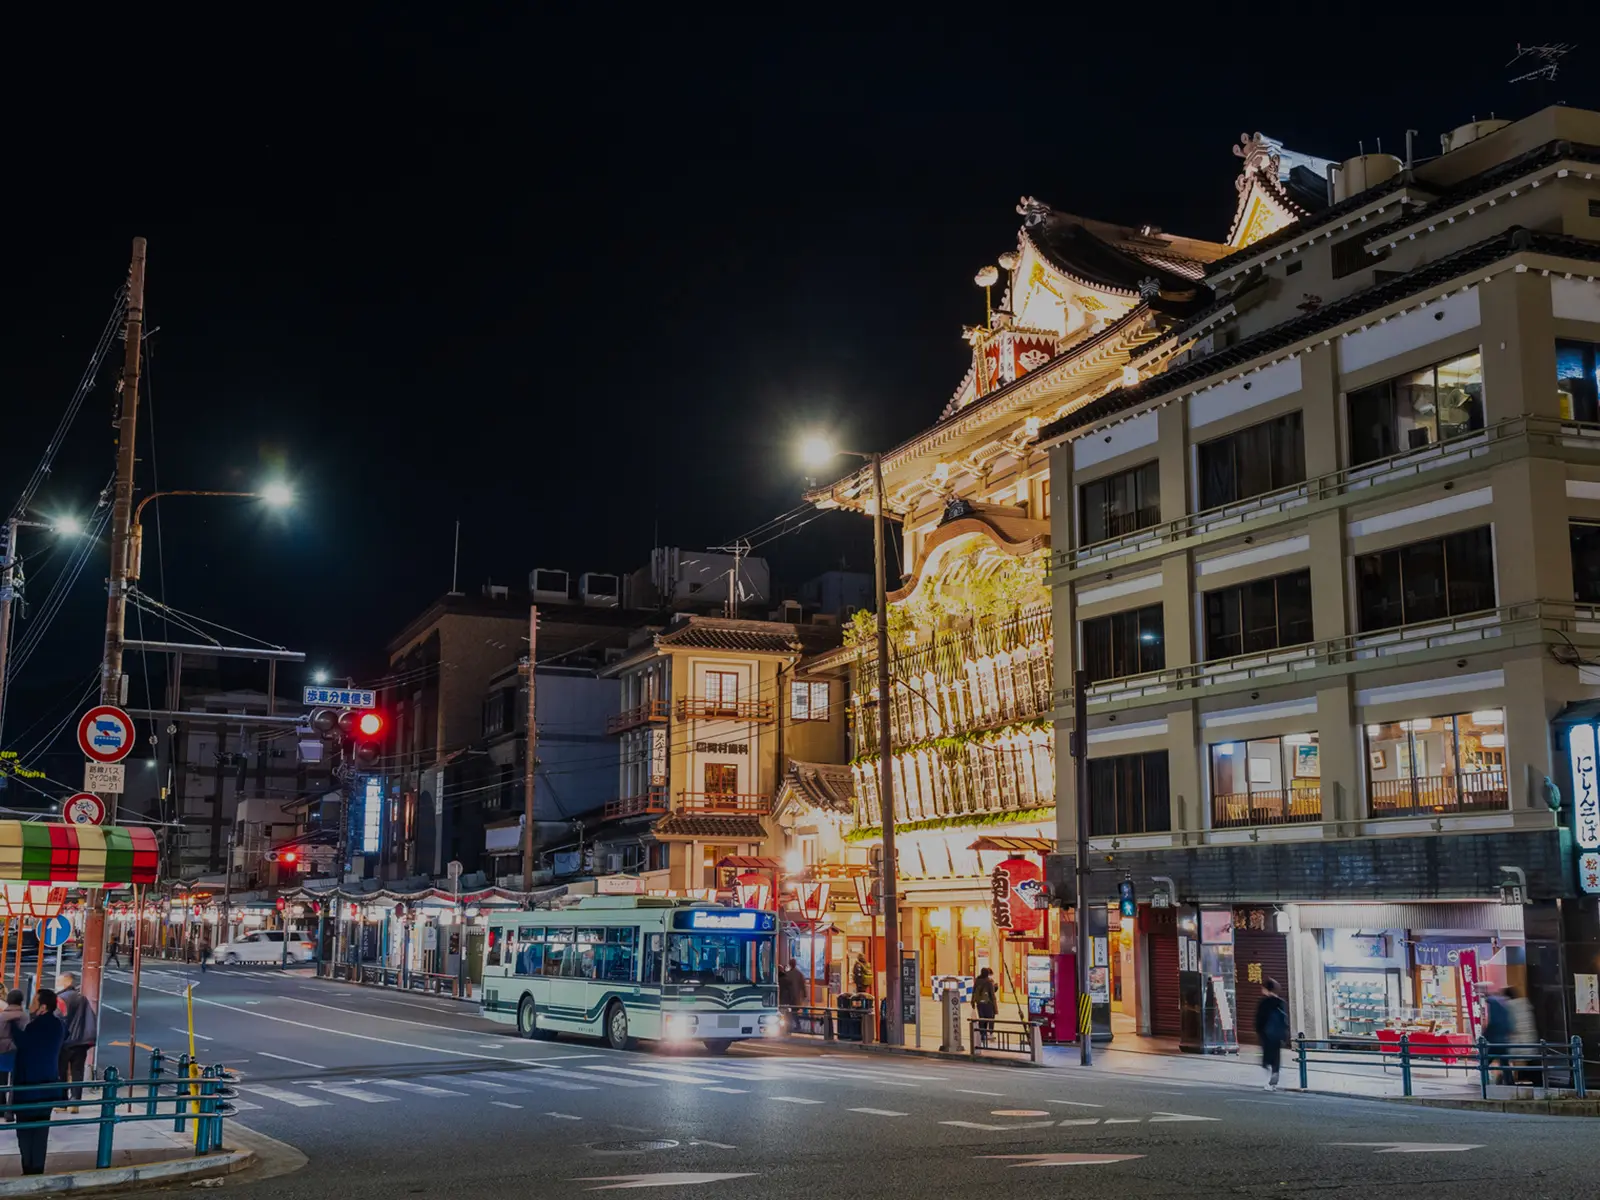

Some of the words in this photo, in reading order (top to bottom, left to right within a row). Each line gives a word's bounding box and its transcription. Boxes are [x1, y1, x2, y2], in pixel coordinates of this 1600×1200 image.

[307, 689, 372, 705] 歩車分離信号
[89, 765, 119, 775] 路線バス
[1585, 858, 1600, 888] 松葉
